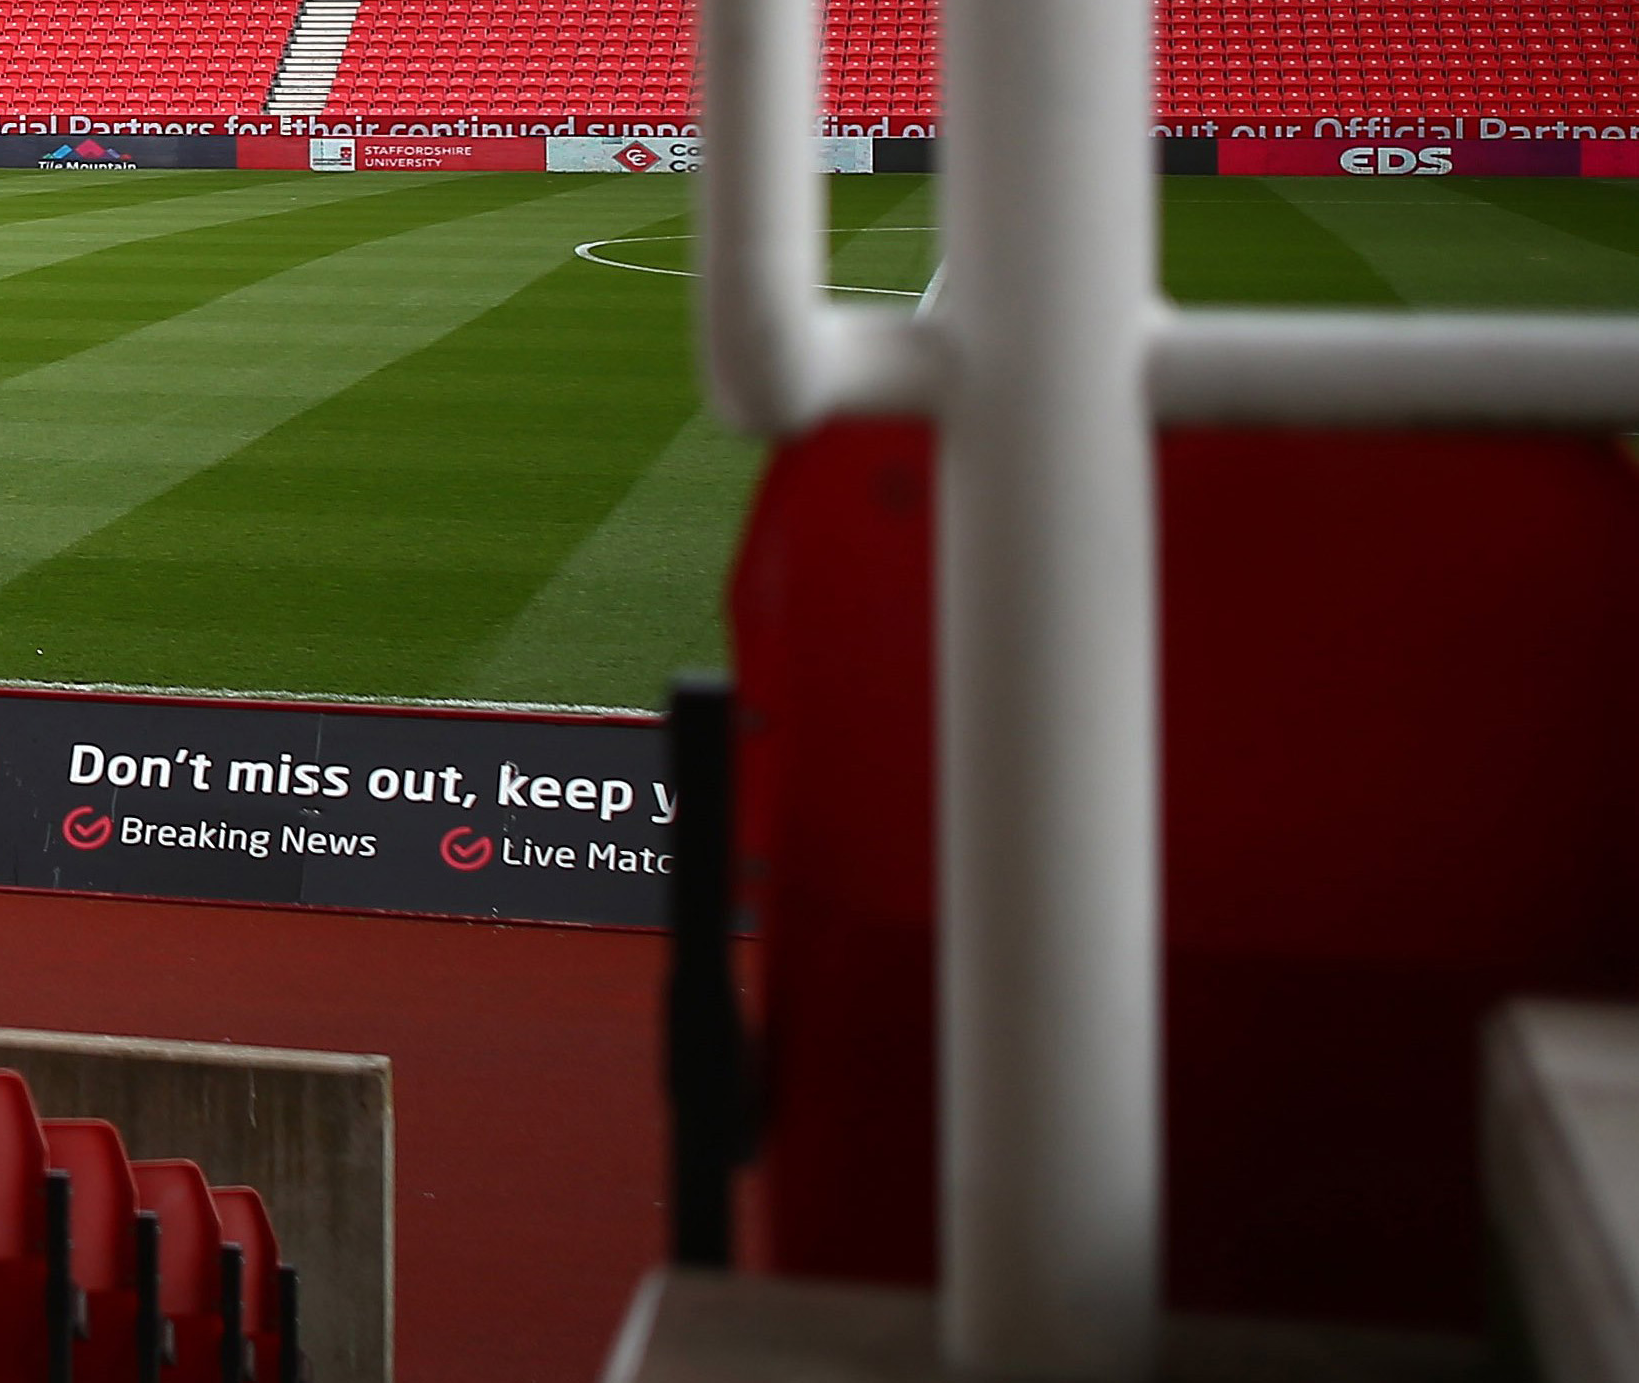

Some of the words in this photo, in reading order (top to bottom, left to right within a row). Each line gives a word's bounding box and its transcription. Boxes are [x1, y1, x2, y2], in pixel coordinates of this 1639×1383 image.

[364, 145, 473, 157] STAFFORDSHIRE
[364, 158, 443, 169] UNIVERSITY
[1339, 147, 1453, 176] EDS
[69, 743, 213, 793] Don't
[226, 753, 350, 799] miss
[367, 767, 479, 810] out,
[497, 761, 636, 817] keep
[121, 817, 272, 858] Breaking
[281, 824, 378, 860] News
[503, 836, 579, 871] Live
[588, 841, 674, 874] Matc
